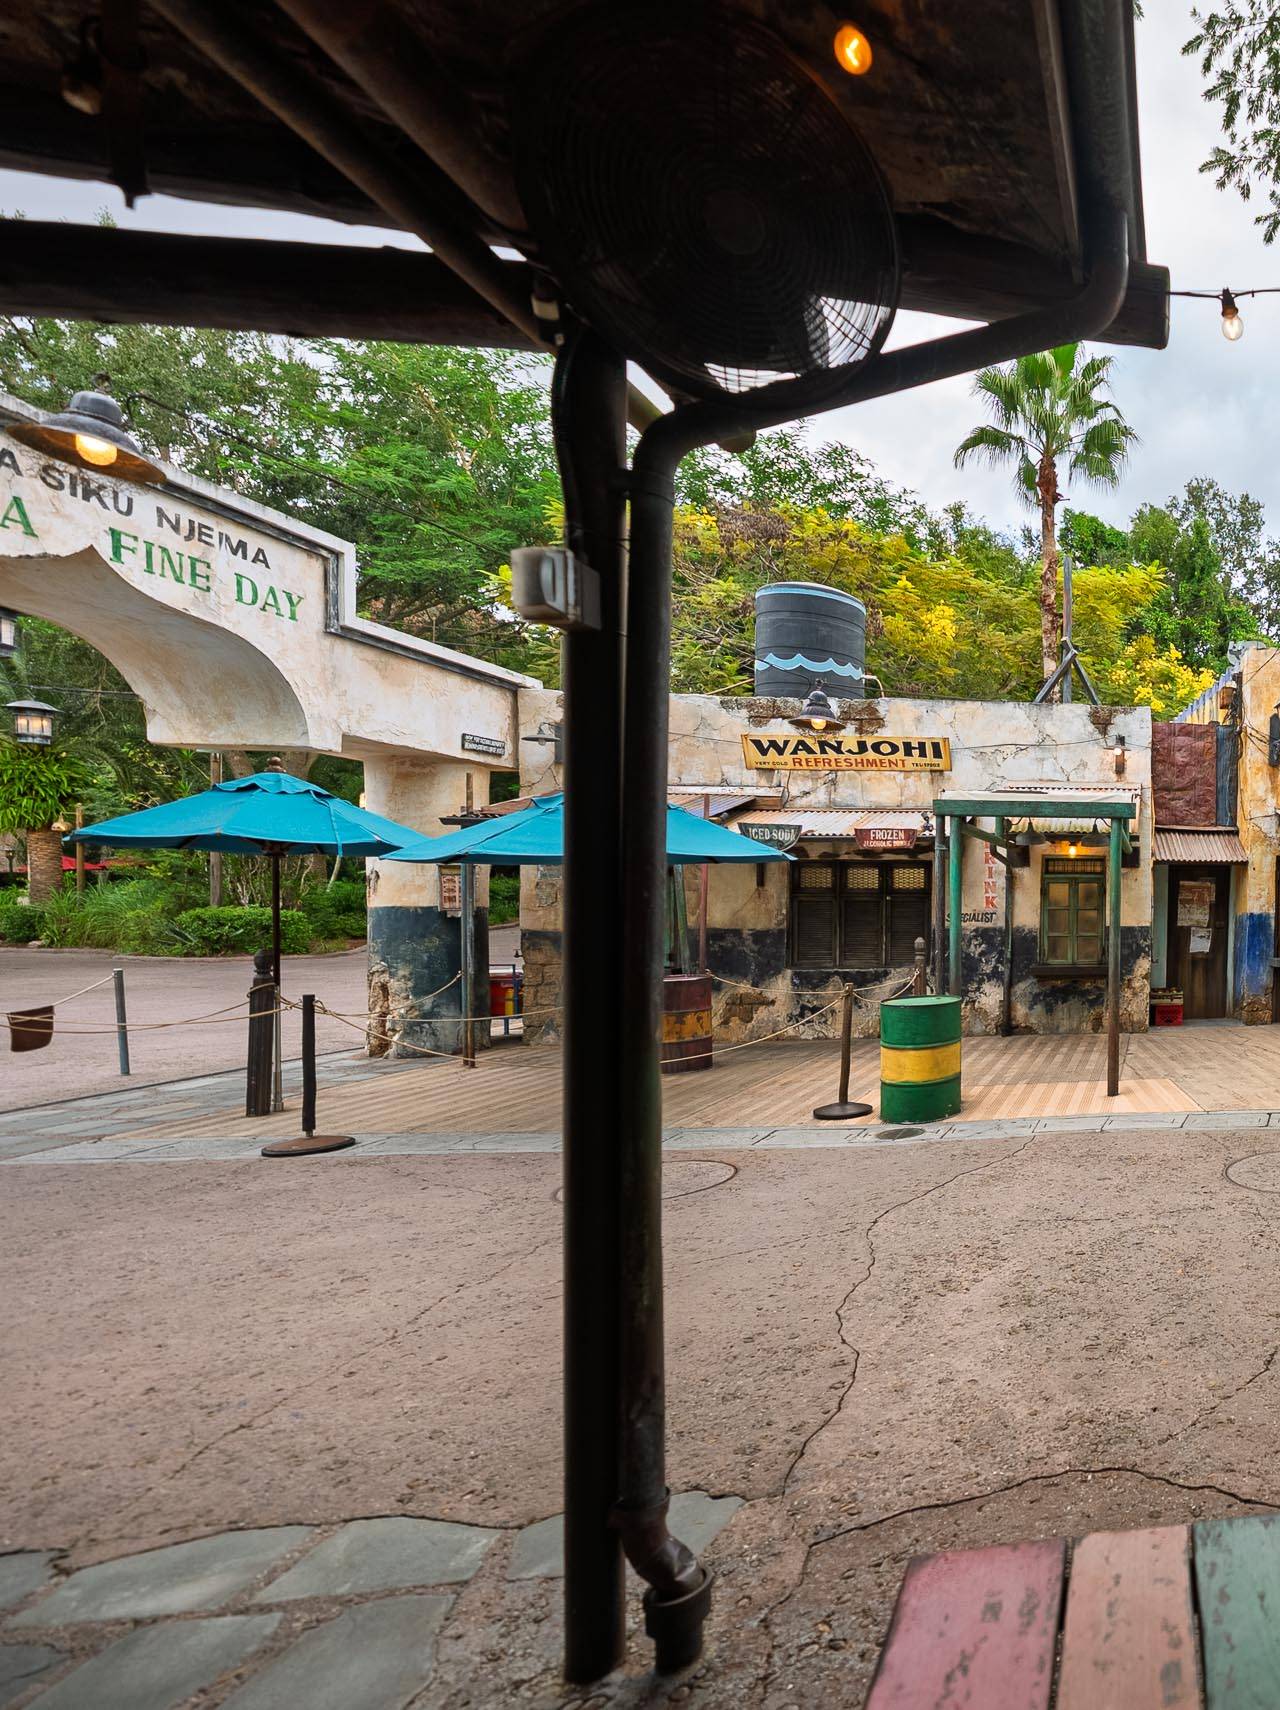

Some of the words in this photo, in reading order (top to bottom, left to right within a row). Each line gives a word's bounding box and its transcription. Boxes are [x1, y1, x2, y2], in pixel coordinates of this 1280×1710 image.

[40, 464, 134, 518] SIKU
[156, 506, 271, 570] NJEMA
[108, 526, 212, 593] FINE
[234, 572, 305, 622] DAY
[749, 739, 944, 760] WANJOHI
[792, 757, 907, 768] REFRESHMENT
[748, 827, 770, 840] ICED
[771, 828, 796, 842] SODA
[870, 829, 905, 840] FROZEN
[946, 910, 997, 923] SECIALIST
